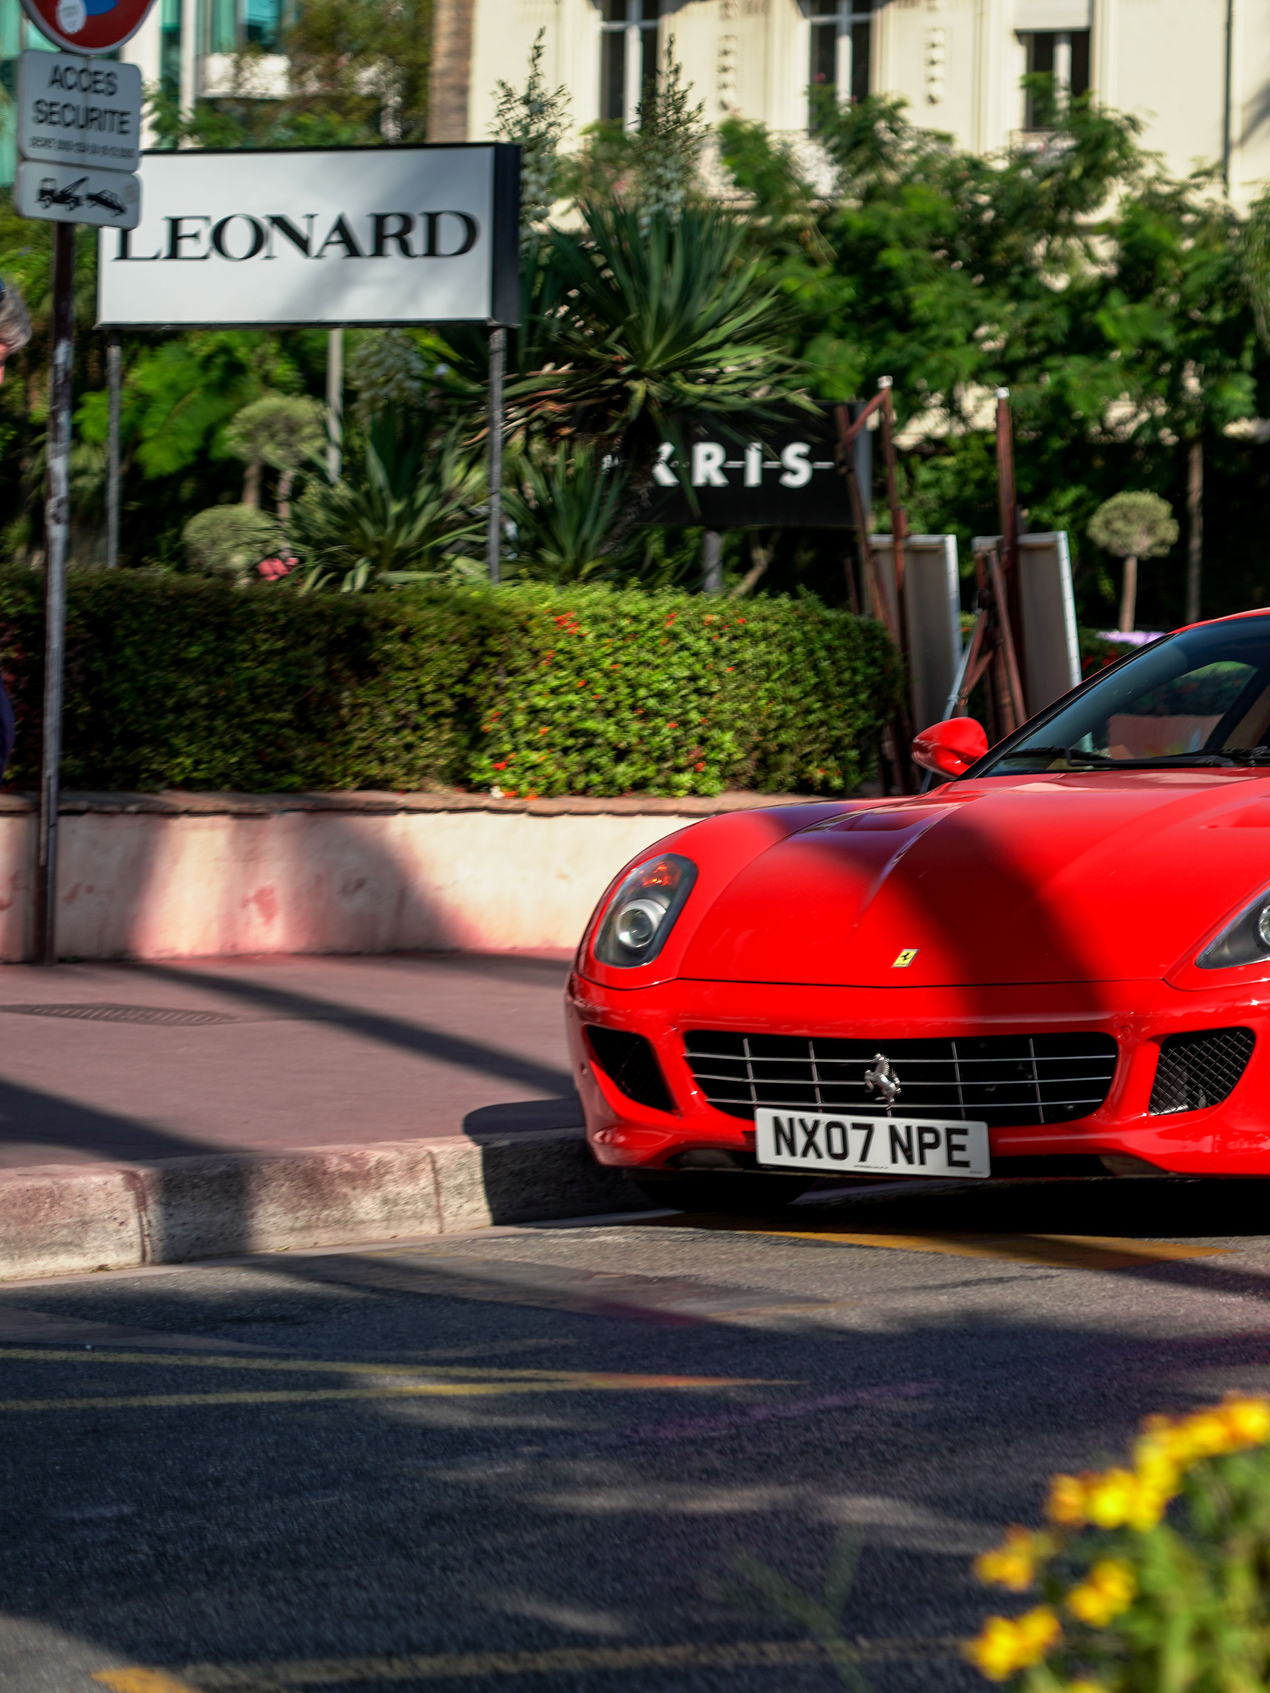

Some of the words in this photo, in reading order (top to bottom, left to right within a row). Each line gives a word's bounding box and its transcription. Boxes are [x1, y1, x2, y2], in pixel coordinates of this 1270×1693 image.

[47, 64, 119, 97] ACCES
[32, 99, 131, 135] SECURITE
[113, 210, 480, 262] LEONARD
[772, 1116, 875, 1162] NX07
[888, 1124, 972, 1168] NPE
